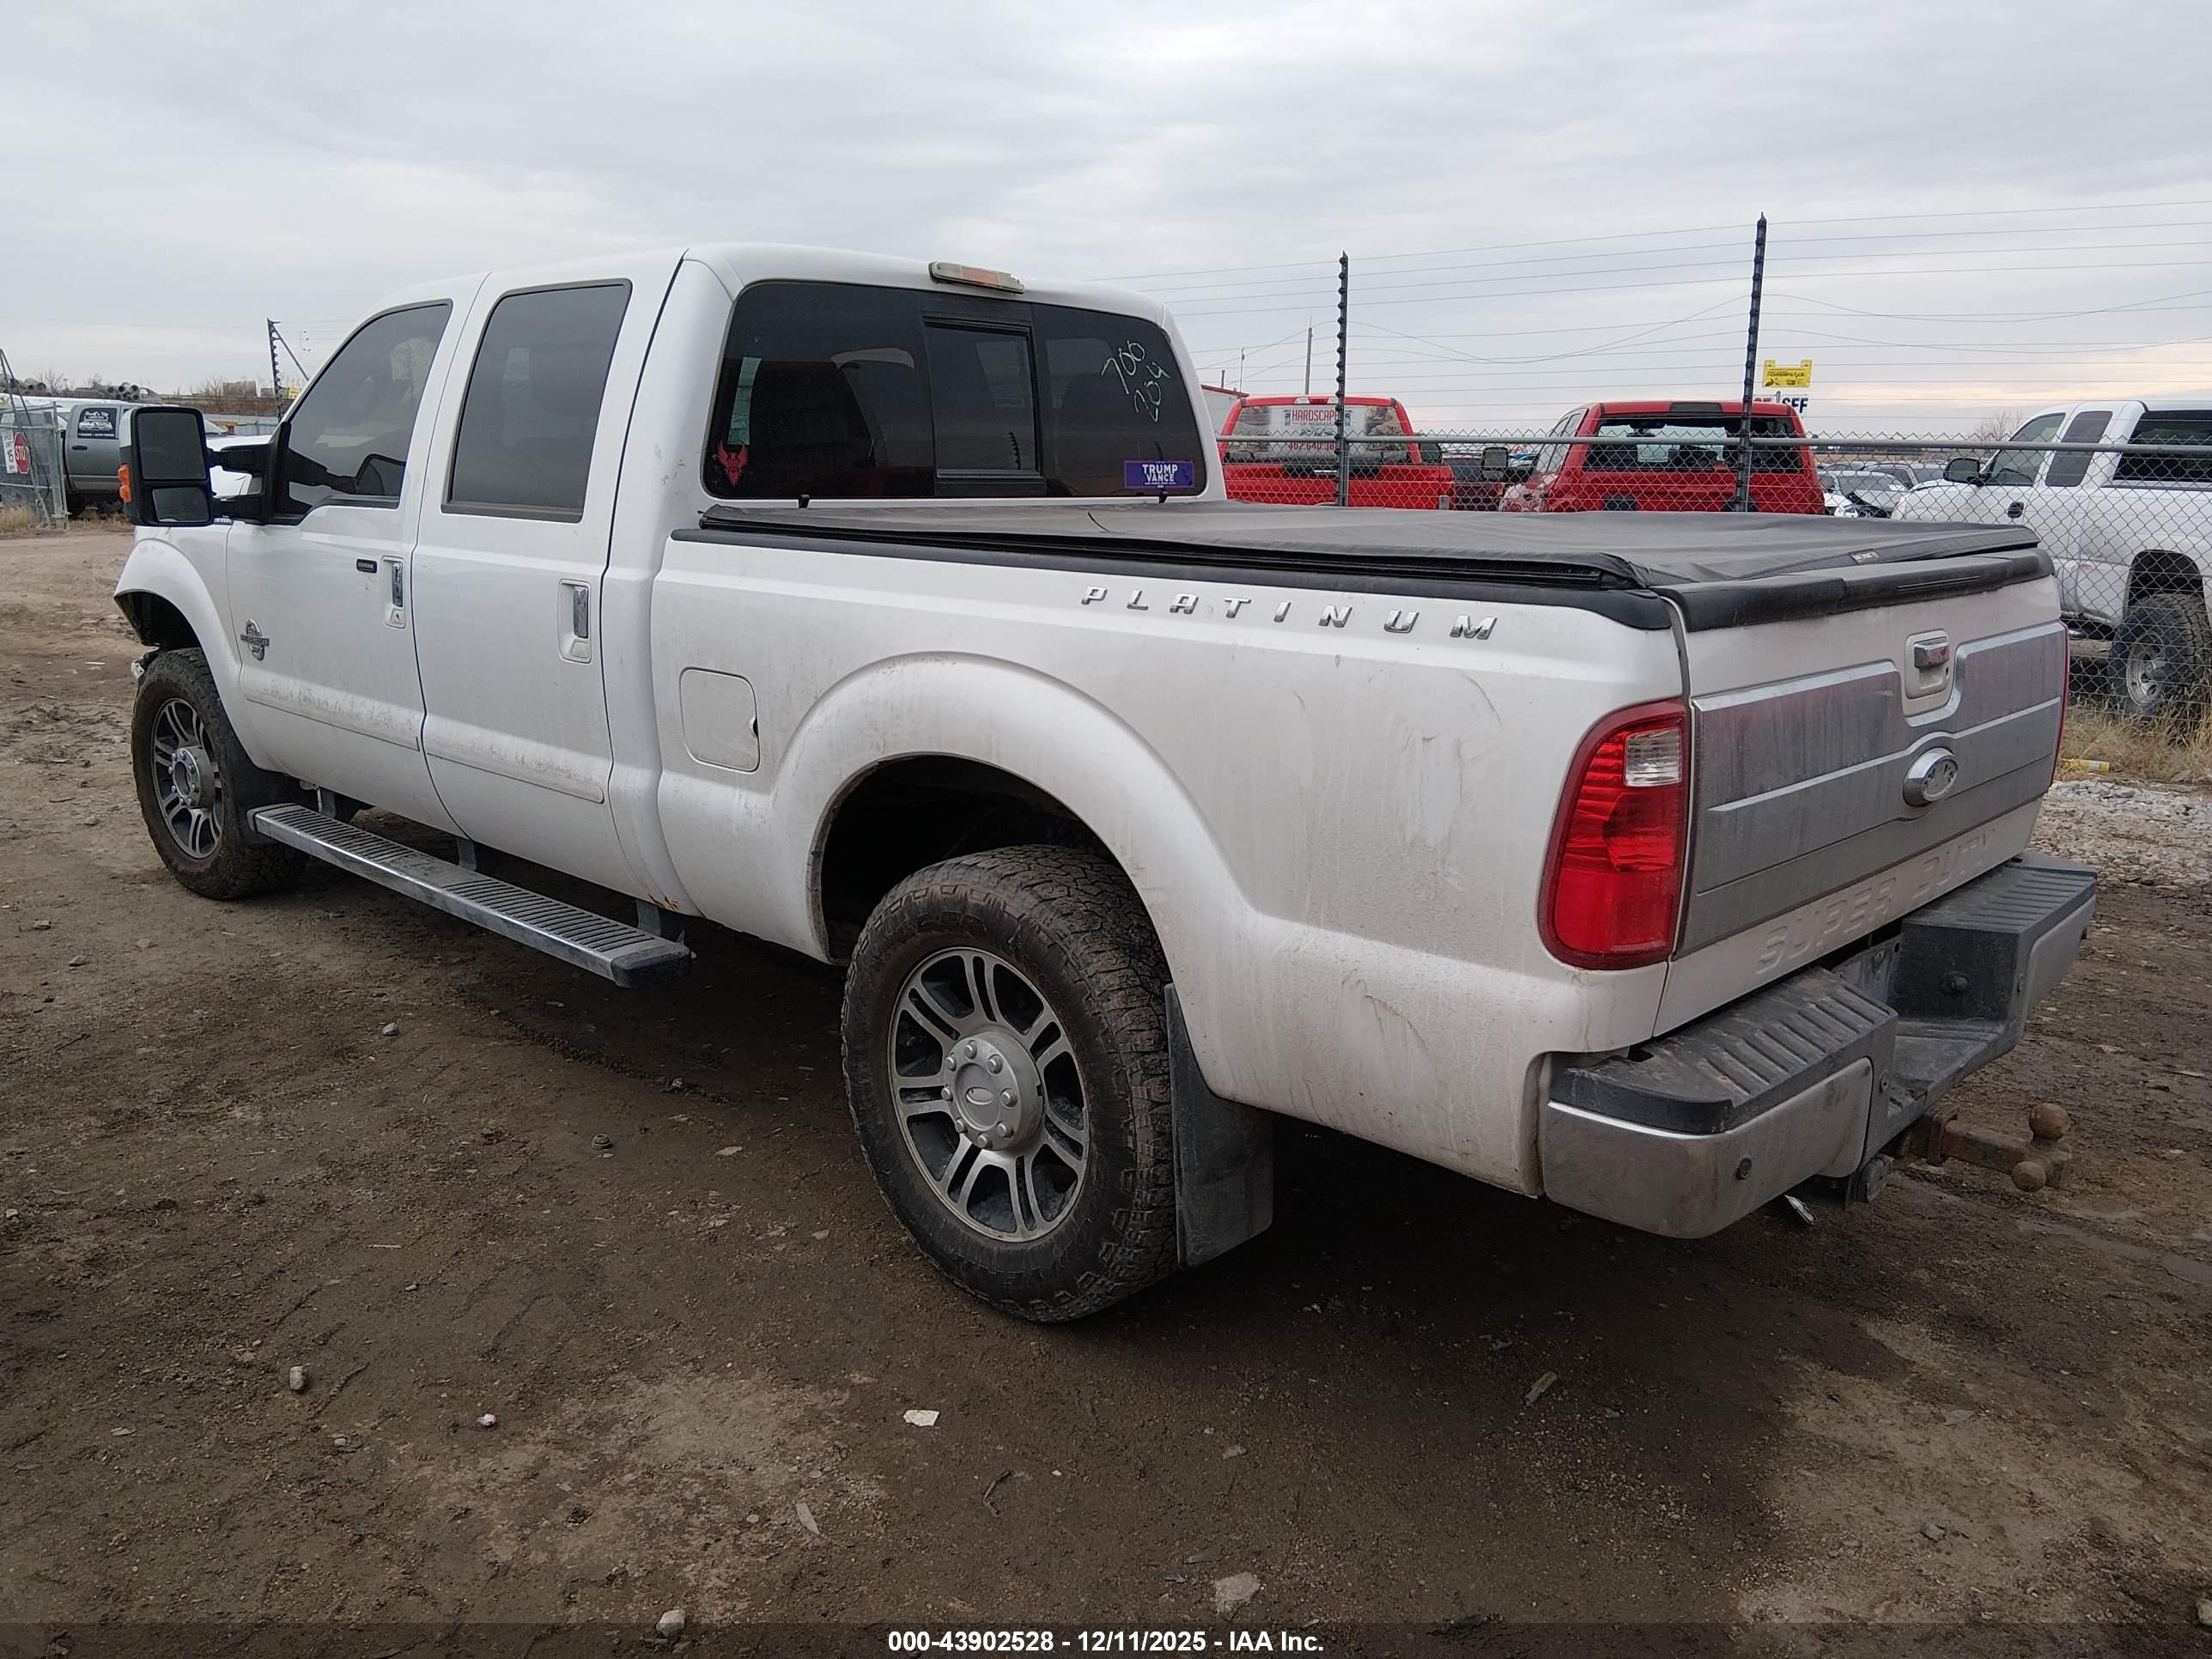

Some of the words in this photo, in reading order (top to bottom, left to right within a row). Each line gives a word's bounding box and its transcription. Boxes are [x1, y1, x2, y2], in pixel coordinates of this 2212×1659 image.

[1291, 410, 1339, 421] HARDSCAPE
[1142, 465, 1178, 474] TRUMP
[1081, 586, 1498, 641] PLATINUM
[1756, 877, 1897, 975] SUPER
[1913, 828, 1996, 899] DUTY
